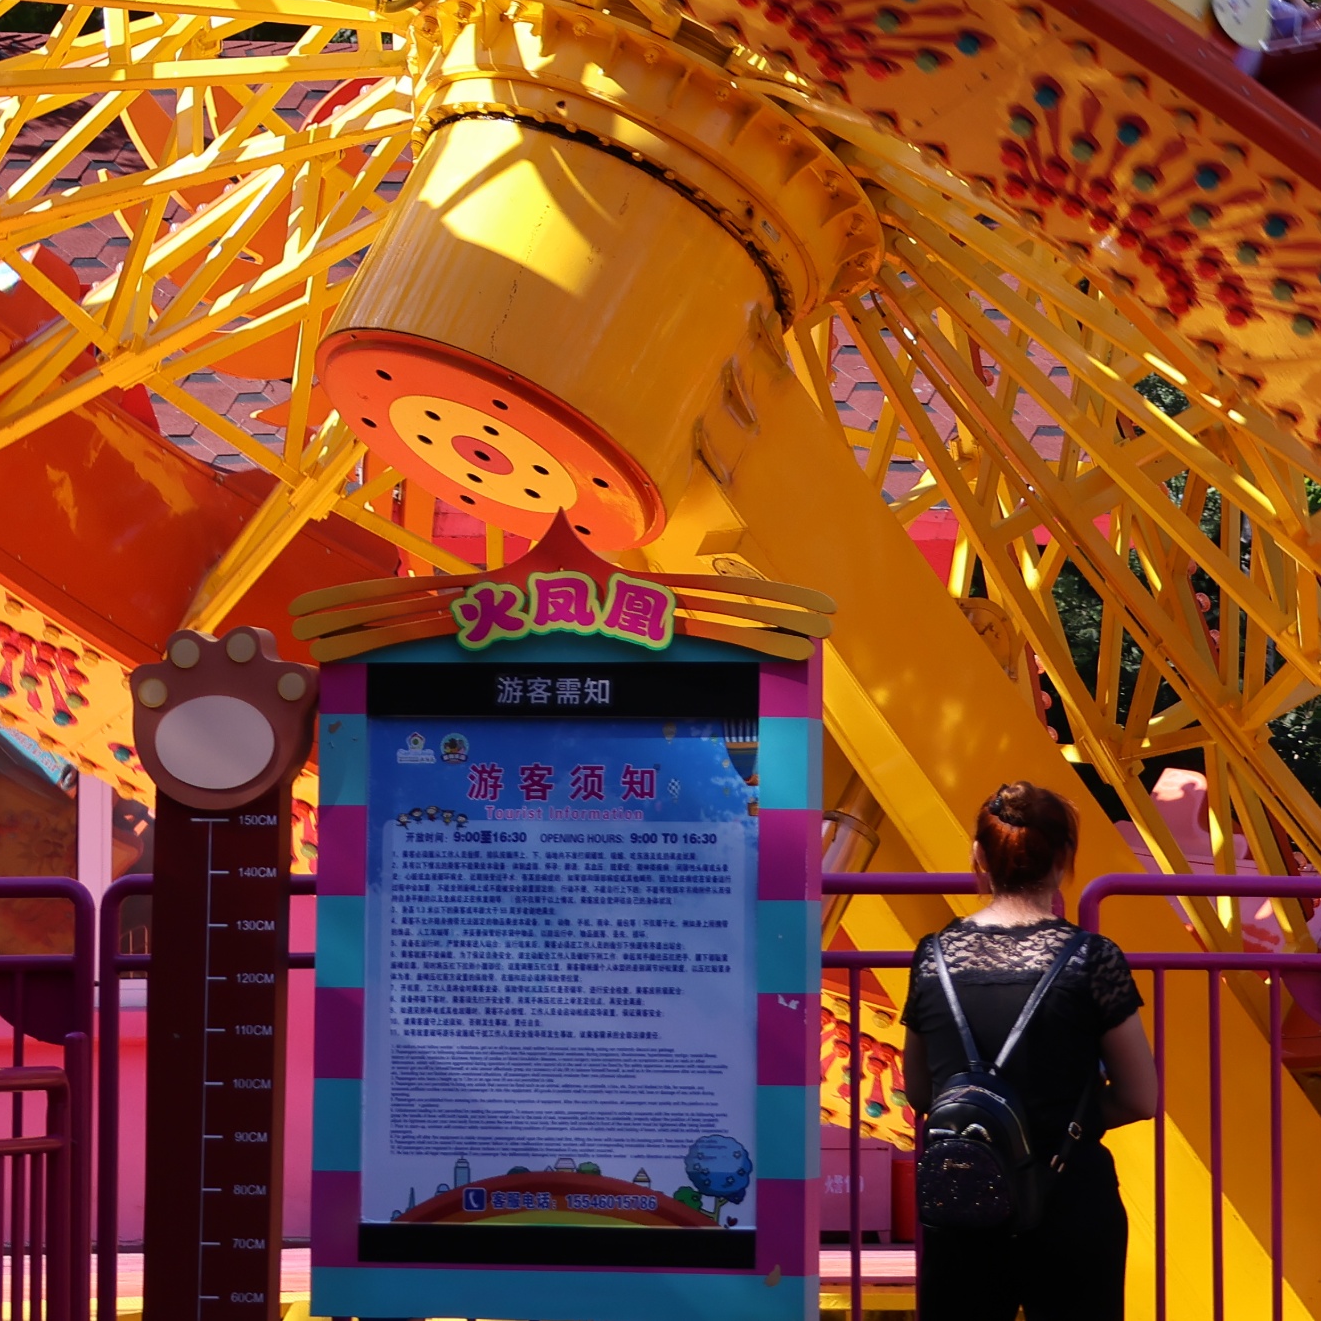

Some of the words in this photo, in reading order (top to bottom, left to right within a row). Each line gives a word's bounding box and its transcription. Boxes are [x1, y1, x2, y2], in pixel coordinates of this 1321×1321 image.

[453, 573, 674, 648] 火凤凰
[496, 677, 611, 705] 游客需知
[466, 762, 658, 801] 游客须知
[485, 805, 543, 821] Tourist
[549, 805, 644, 821] Information
[239, 814, 277, 825] 150CM
[540, 833, 585, 844] OPENING
[630, 833, 658, 845] 9:00
[682, 833, 718, 845] 16:30
[238, 867, 277, 878] 140CM
[236, 920, 275, 931] 130CM
[236, 973, 275, 984] 120CM
[235, 1025, 273, 1036] 110CM
[233, 1078, 272, 1089] 100CM
[234, 1132, 268, 1142] 90CM
[233, 1185, 267, 1195] 80CM
[232, 1238, 266, 1249] 70CM
[230, 1292, 264, 1303] 60CM
